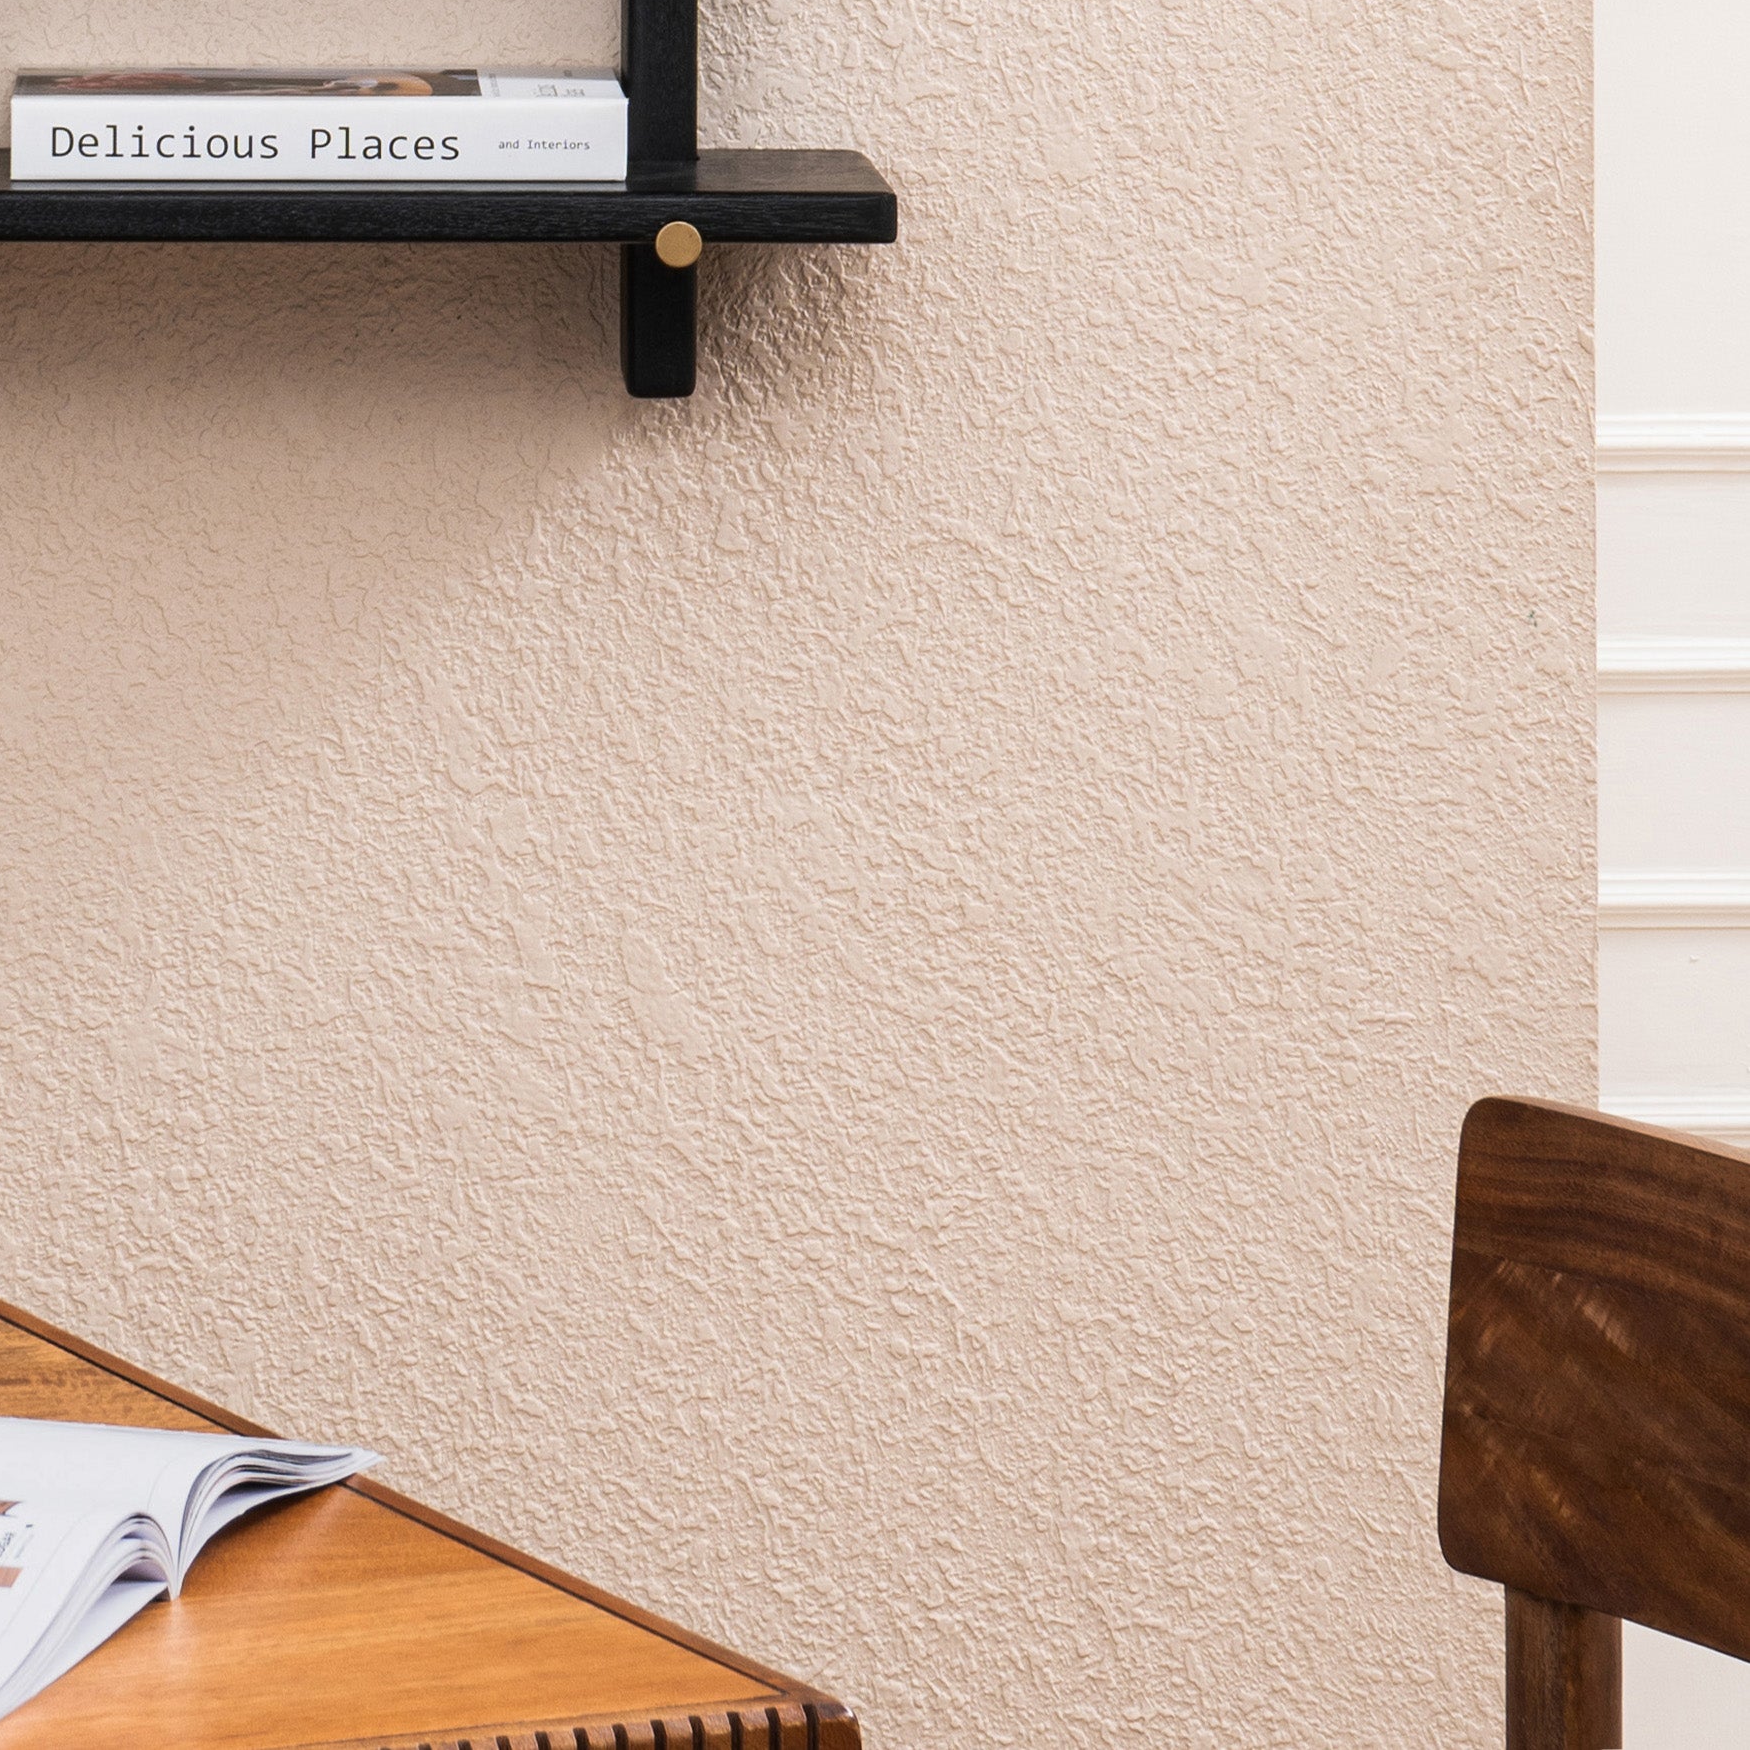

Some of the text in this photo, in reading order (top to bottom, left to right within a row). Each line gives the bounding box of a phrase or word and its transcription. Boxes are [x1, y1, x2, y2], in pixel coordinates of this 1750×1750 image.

[52, 125, 460, 160] Delicious Places
[498, 139, 590, 151] and Interiors
